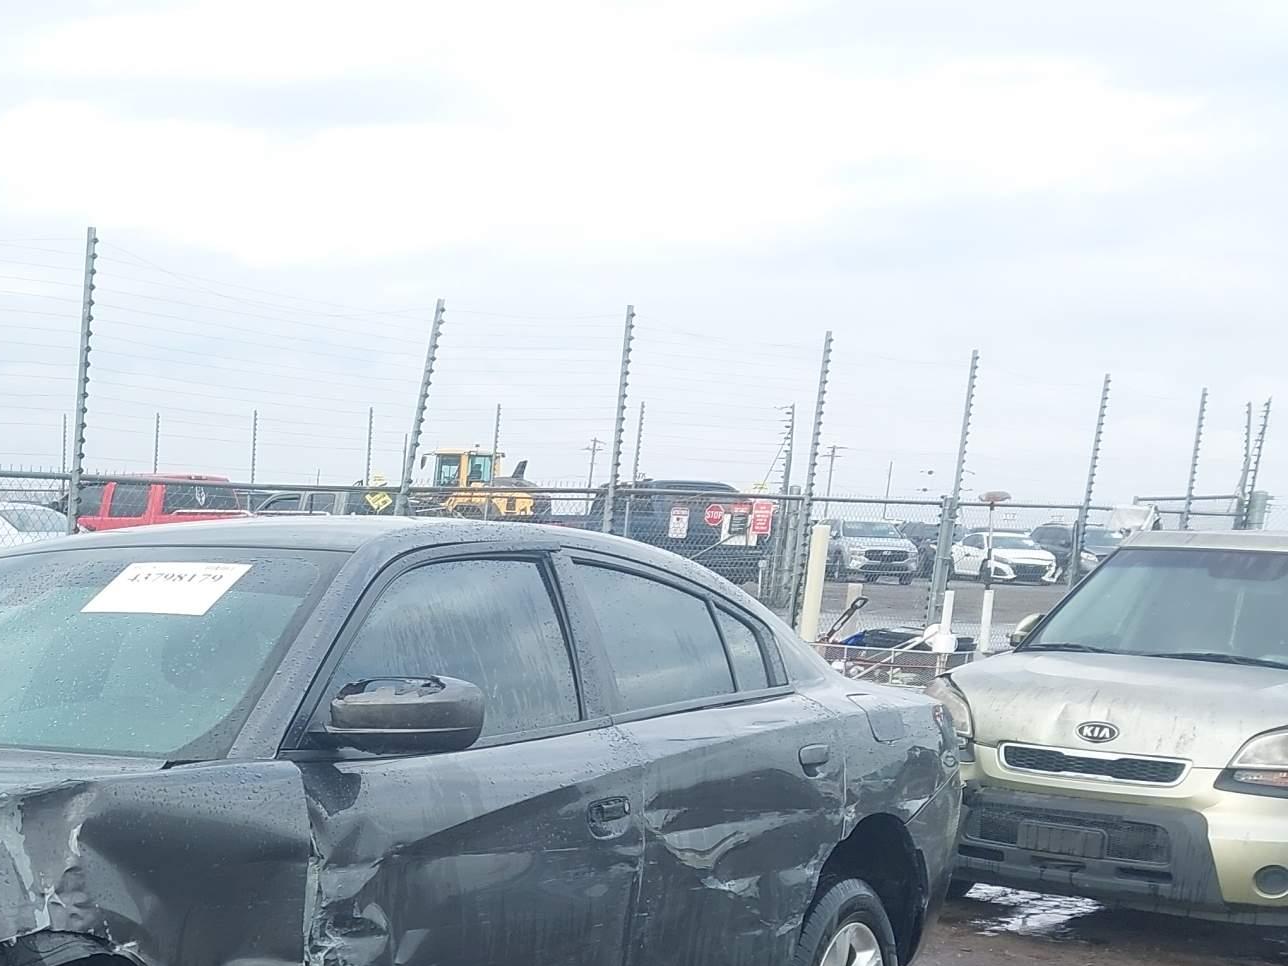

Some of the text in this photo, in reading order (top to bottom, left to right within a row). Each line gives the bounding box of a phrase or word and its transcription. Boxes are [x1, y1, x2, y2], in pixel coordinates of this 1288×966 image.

[705, 511, 722, 520] STOP
[128, 572, 224, 583] 43798179
[1083, 726, 1110, 738] KIA
